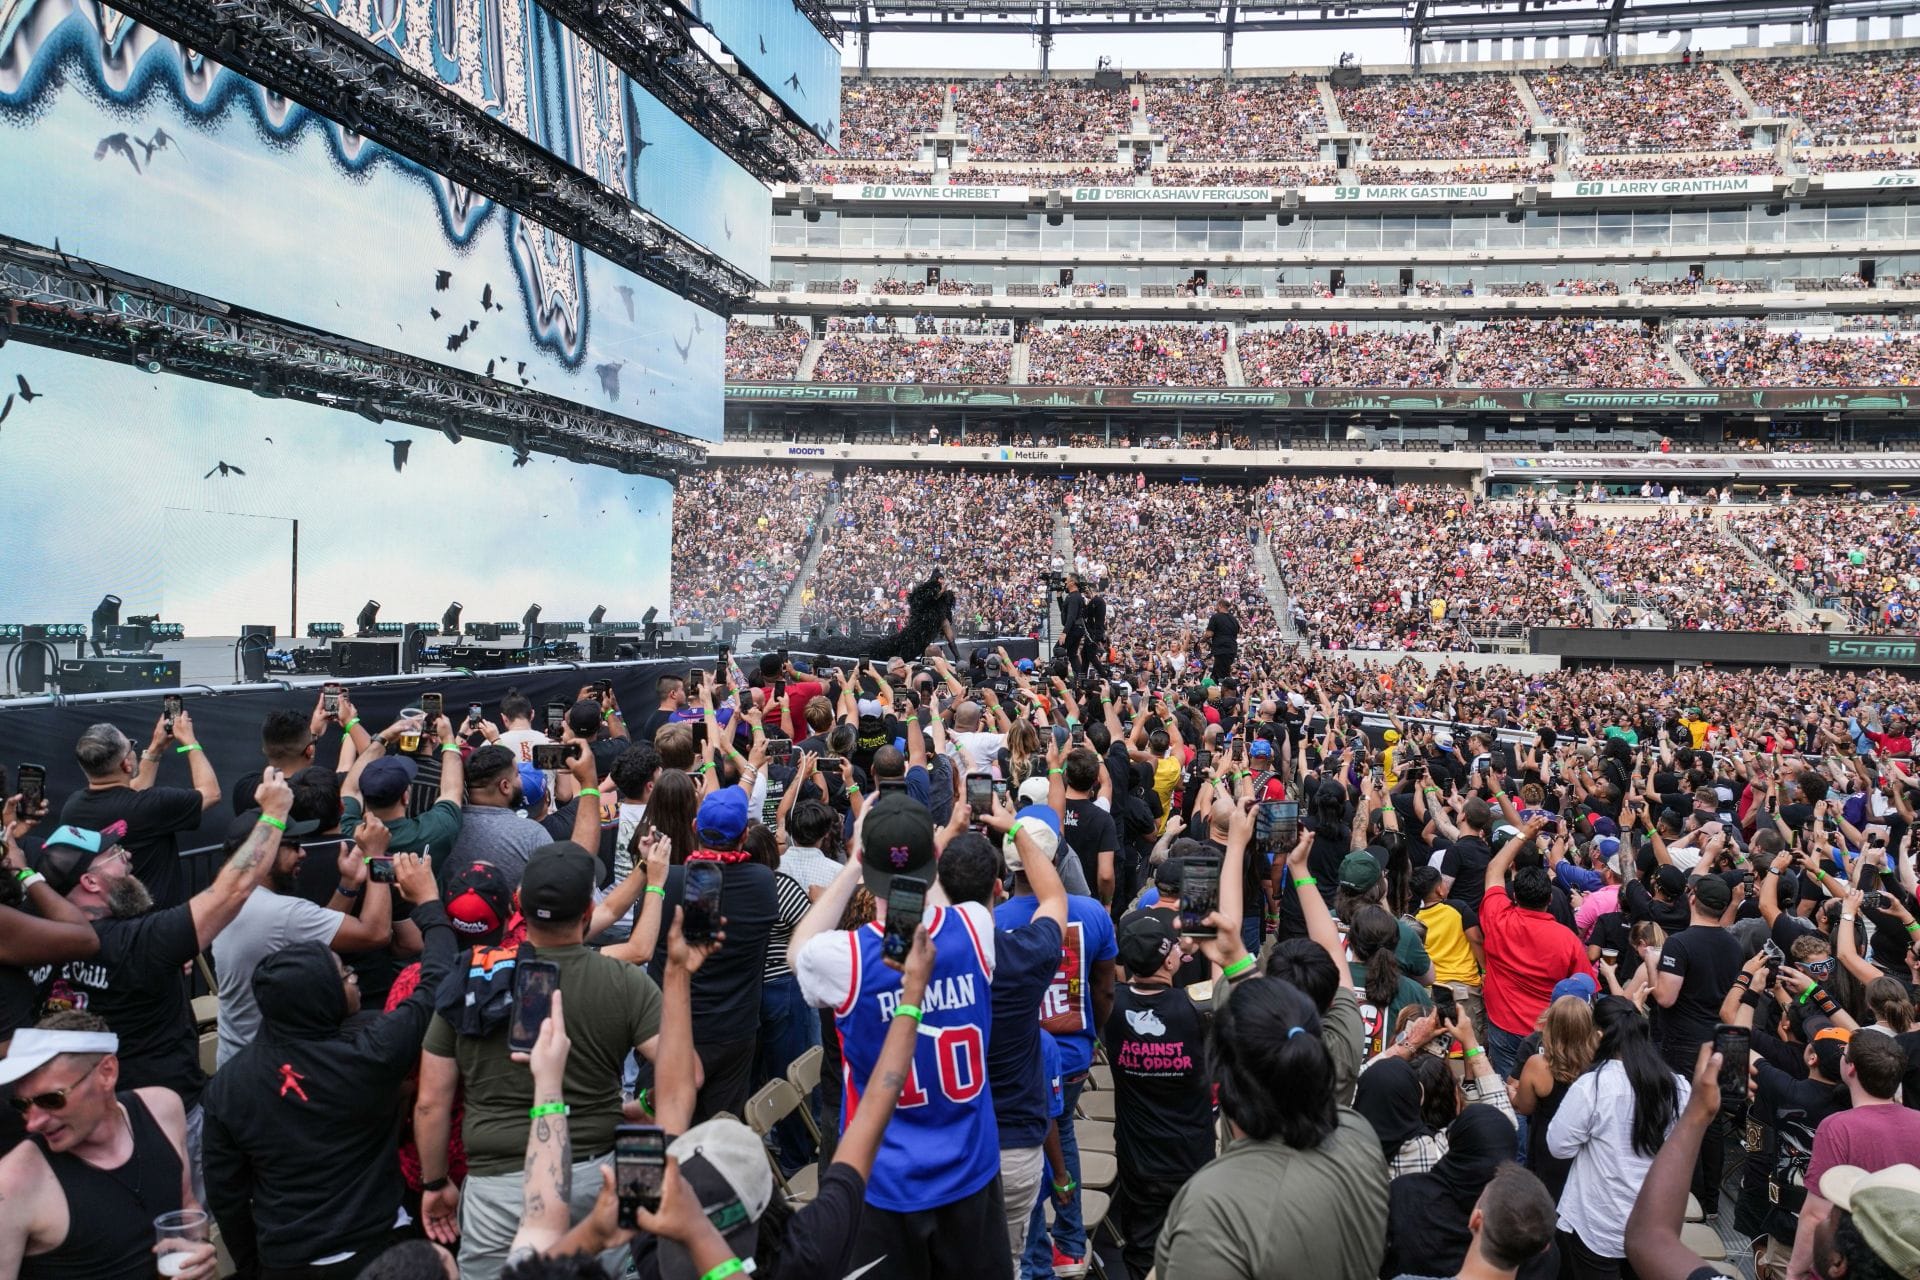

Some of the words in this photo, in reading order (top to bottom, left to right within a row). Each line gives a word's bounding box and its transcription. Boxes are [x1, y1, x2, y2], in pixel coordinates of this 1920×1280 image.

[1872, 175, 1916, 186] JETS
[861, 186, 887, 199] 80
[892, 187, 939, 198] WAYNE
[942, 187, 1001, 199] CHREBET
[1335, 187, 1361, 200] 99
[1366, 187, 1408, 199] MARK
[1411, 186, 1488, 198] GASTINEAU
[1575, 182, 1604, 196] 60
[1610, 182, 1659, 194] LARRY
[1661, 179, 1748, 193] GRANTHAM
[1075, 188, 1101, 200] 60
[1202, 189, 1269, 200] FERGUSON
[788, 447, 825, 456] MOODY'S
[1015, 451, 1049, 460] MetLife
[1541, 459, 1603, 467] MetLife
[1773, 459, 1857, 469] METLIFE
[1861, 459, 1920, 469] STADI
[876, 973, 977, 1023] RMAN
[1121, 1041, 1184, 1057] AGAINST
[1118, 1054, 1140, 1069] ALL
